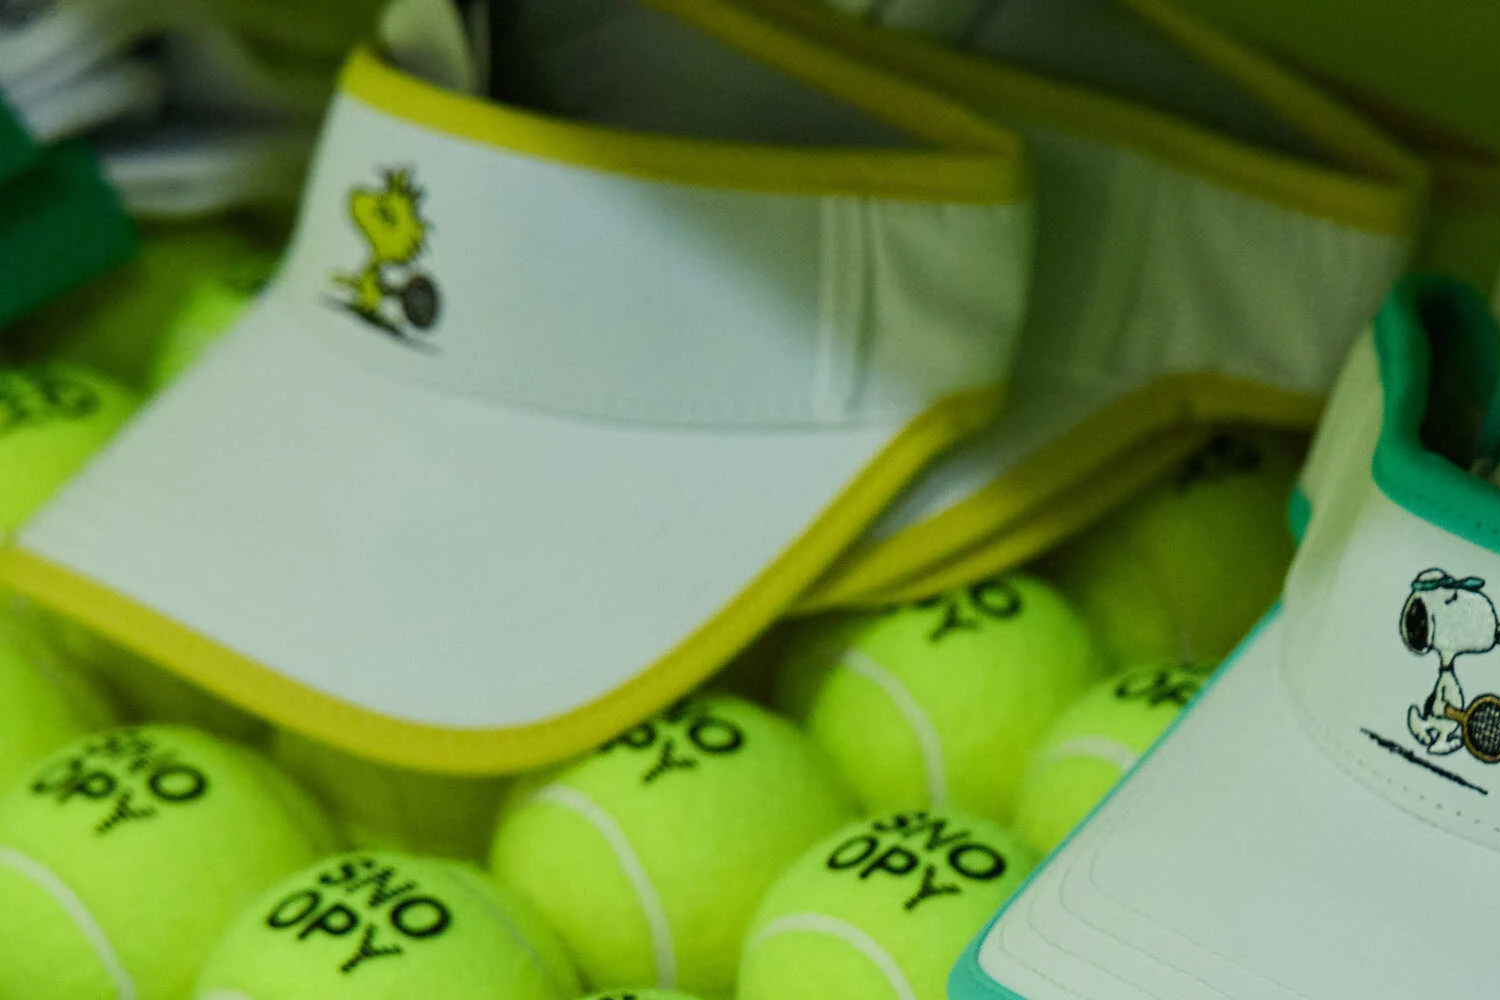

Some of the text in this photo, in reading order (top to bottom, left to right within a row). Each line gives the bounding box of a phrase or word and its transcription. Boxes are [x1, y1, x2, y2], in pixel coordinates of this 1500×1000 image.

[597, 717, 698, 786] PY
[826, 836, 961, 911] OPY
[873, 811, 1004, 881] SNO
[267, 890, 402, 974] OPY
[318, 859, 451, 939] SNO
